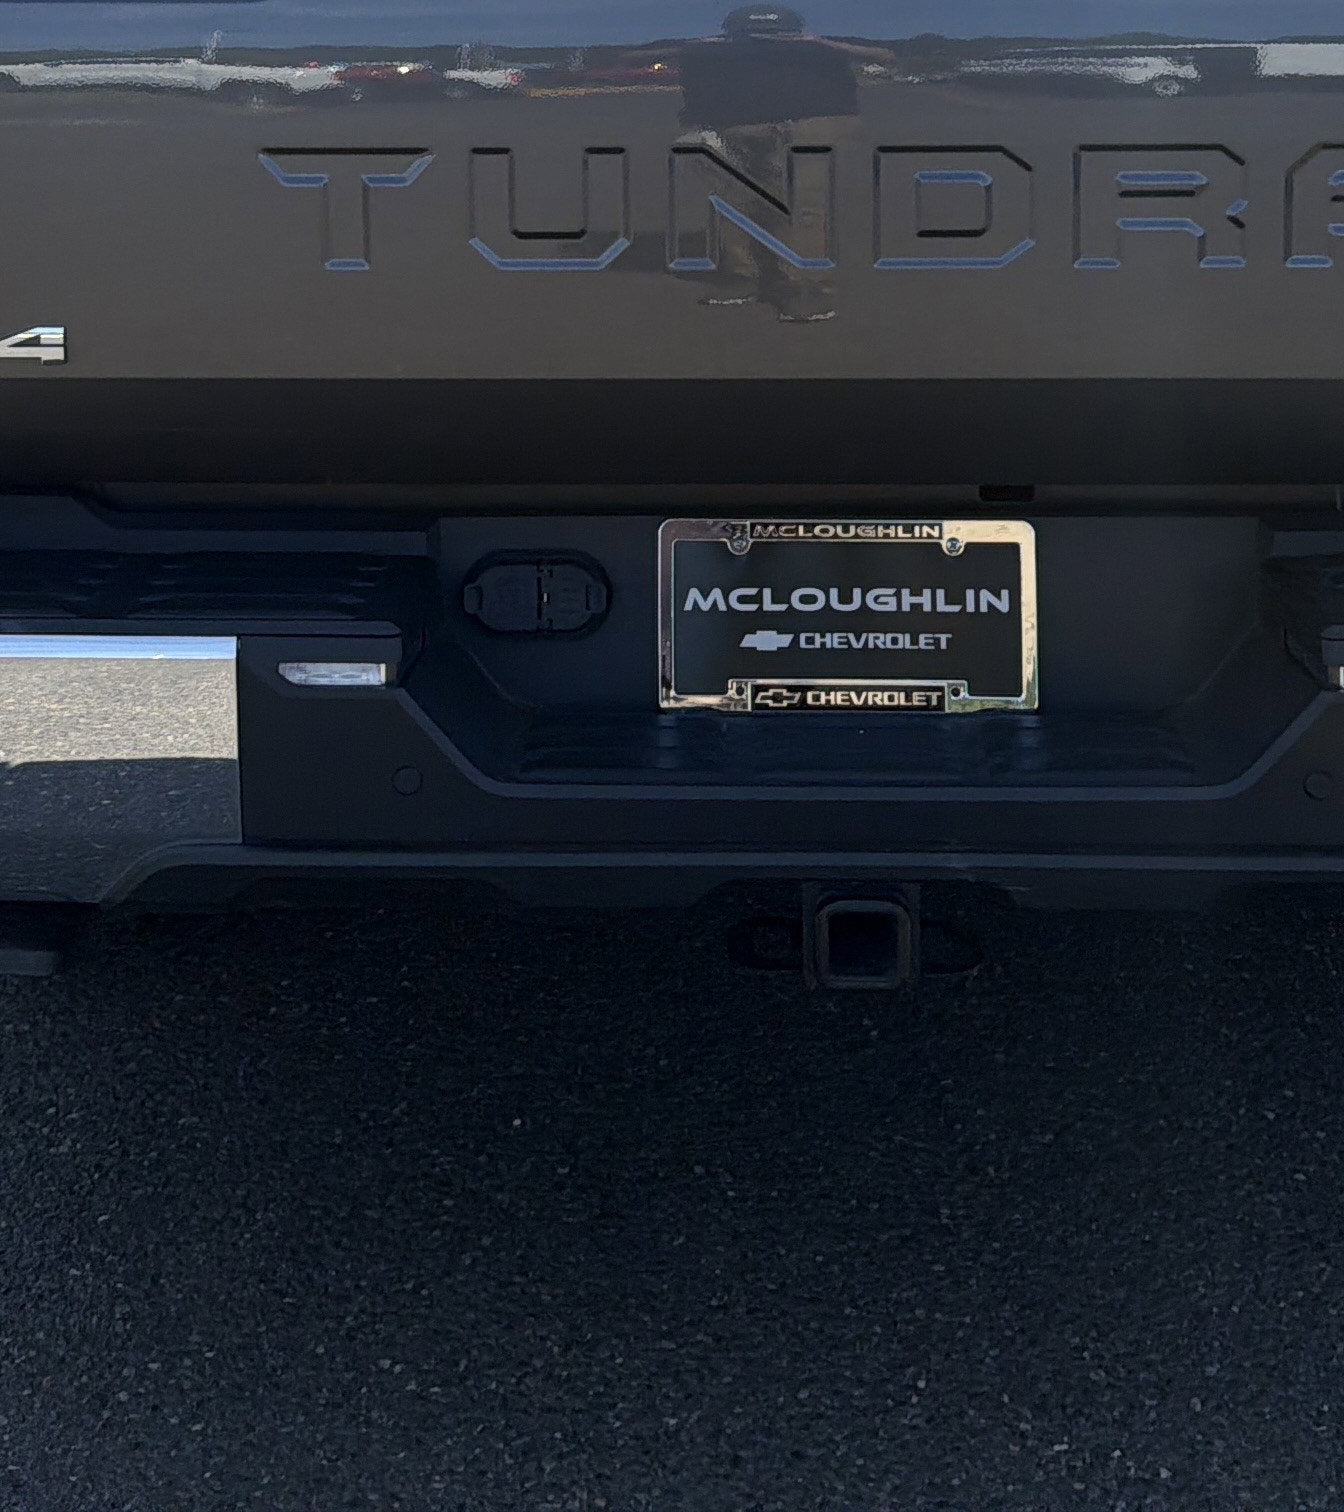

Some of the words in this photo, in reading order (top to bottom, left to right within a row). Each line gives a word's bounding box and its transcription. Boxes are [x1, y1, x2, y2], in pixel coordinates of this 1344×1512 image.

[753, 524, 941, 540] MCLOUGHLIN
[683, 587, 1011, 614] MCLOUGHLIN
[798, 632, 953, 651] CHEVROLET
[806, 690, 944, 707] CHEVROLET
